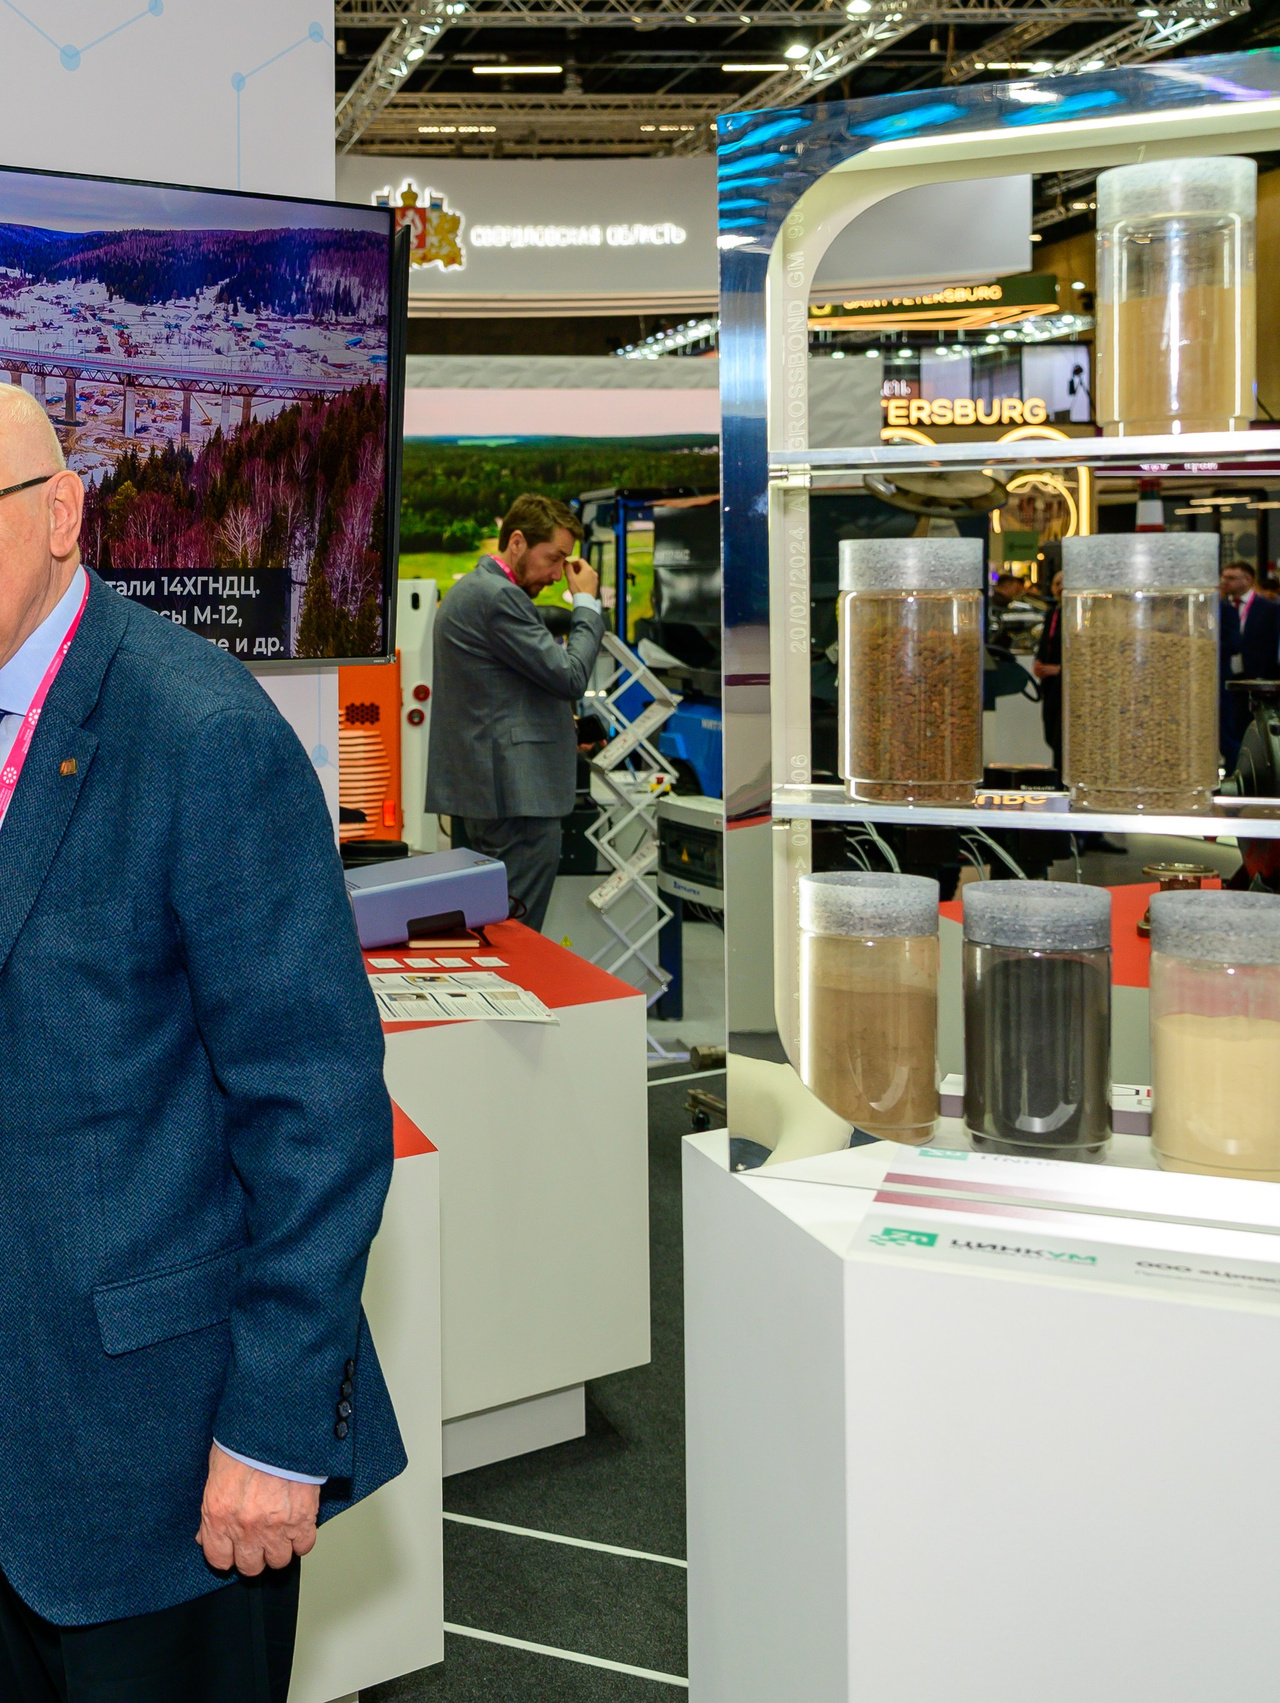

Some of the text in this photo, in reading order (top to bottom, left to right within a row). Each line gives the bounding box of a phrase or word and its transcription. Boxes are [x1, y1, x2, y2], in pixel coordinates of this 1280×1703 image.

[787, 251, 805, 288] GM
[787, 300, 806, 451] GROSSBOND
[881, 398, 1047, 426] ERSBURG
[108, 579, 156, 597] тали
[161, 576, 261, 598] 14ХГНДЦ.
[789, 526, 807, 653] 20/02/2024
[154, 610, 187, 625] сы
[194, 605, 243, 627] М-12,
[236, 637, 247, 652] и
[253, 637, 284, 656] др.
[950, 1238, 1098, 1263] ЦИНКУМ
[1136, 1261, 1192, 1273] ООО
